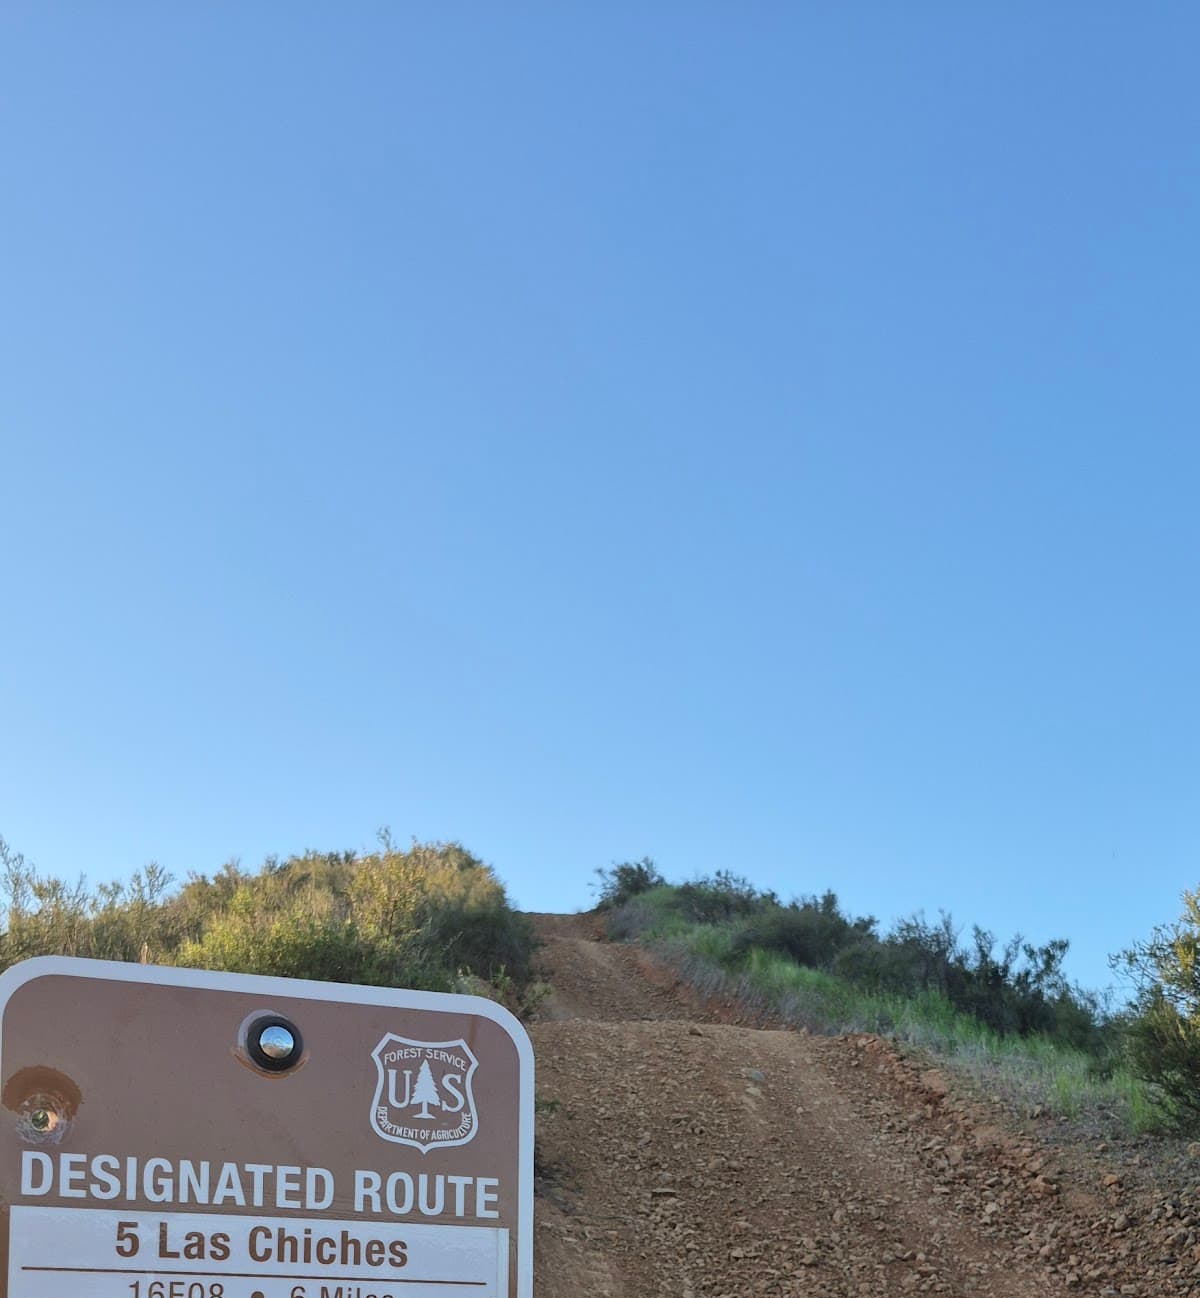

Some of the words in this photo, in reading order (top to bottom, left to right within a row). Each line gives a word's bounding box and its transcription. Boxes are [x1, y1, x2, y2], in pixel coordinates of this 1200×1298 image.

[384, 1048, 423, 1065] FOREST
[425, 1048, 467, 1072] SERVICE
[377, 1105, 419, 1139] DEPARTMENT
[420, 1129, 430, 1140] OF
[431, 1111, 472, 1141] AGRICULTURE
[20, 1150, 335, 1210] DESIGNATED
[353, 1170, 500, 1218] ROUTE
[115, 1221, 140, 1258] 5
[158, 1222, 231, 1262] Las
[248, 1225, 409, 1268] Chiches
